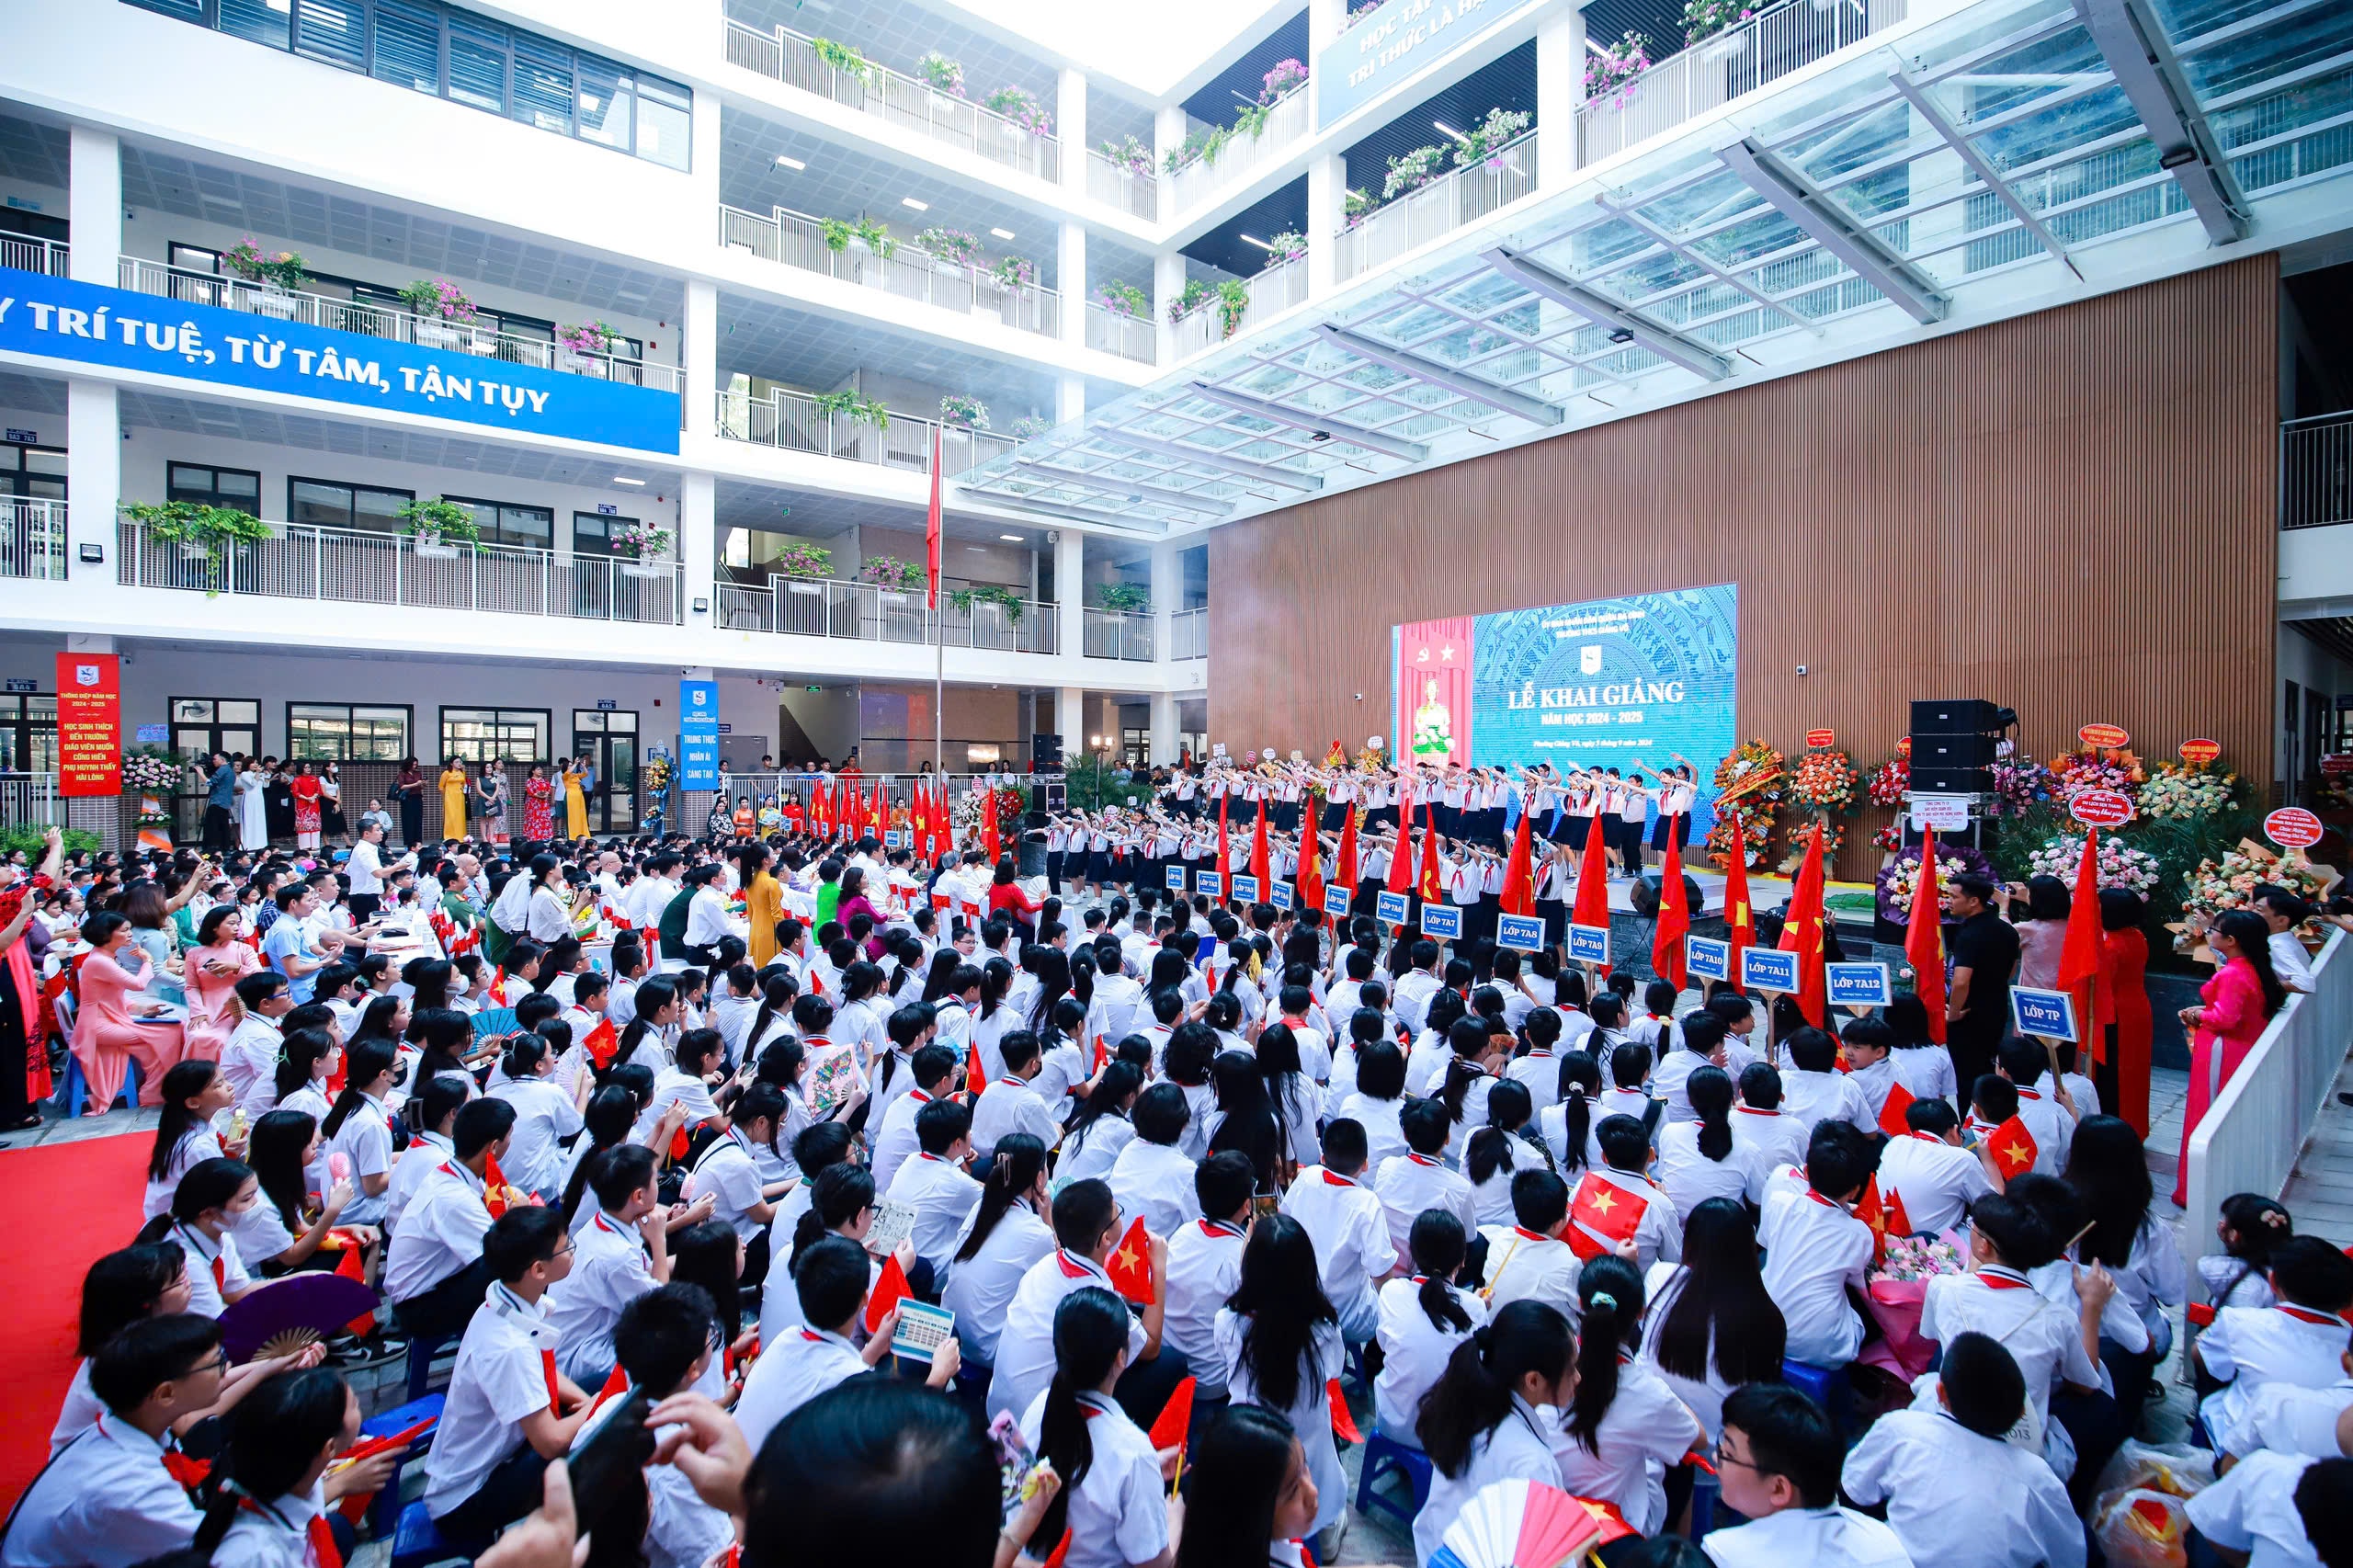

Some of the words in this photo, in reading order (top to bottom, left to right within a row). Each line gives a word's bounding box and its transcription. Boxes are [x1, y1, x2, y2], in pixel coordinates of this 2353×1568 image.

[1430, 5, 1454, 36] LÀ
[1360, 16, 1398, 53] HỌC
[27, 301, 110, 341] TRÍ
[116, 317, 216, 365] TUỆ,
[224, 334, 286, 369] TỪ
[292, 346, 390, 393] TÂM,
[398, 364, 472, 403] TẬN
[478, 381, 550, 416] TỤY
[1507, 681, 1535, 709] LỄ
[1540, 687, 1597, 709] KHAI
[1603, 676, 1685, 706] GIẢNG
[1541, 711, 1563, 725] NĂM
[1564, 712, 1585, 727] HỌC
[1586, 711, 1609, 724] 2024
[1619, 710, 1643, 723] 2025
[64, 722, 77, 731] HỌC
[95, 722, 113, 730] THÍCH
[684, 734, 701, 744] TRUNG
[689, 750, 705, 761] NHÂN
[63, 764, 76, 772] PHỤ
[702, 769, 713, 779] TẠO
[1234, 883, 1245, 892] LỚP
[1327, 893, 1336, 903] LỚP
[1380, 900, 1392, 910] LỚP
[1392, 904, 1403, 913] 7A6
[1427, 915, 1441, 925] LỚP
[1442, 918, 1456, 927] 7A7
[1503, 925, 1519, 936] LỚP
[1520, 929, 1538, 938] 7A8
[1573, 936, 1587, 948] LỚP
[1587, 940, 1603, 950] 7A9
[1691, 949, 1704, 961] LỚP
[1705, 954, 1722, 965] 7A10
[1748, 961, 1767, 973] LỚP
[1768, 966, 1790, 977] 7A11
[1833, 976, 1854, 988] LỚP
[1854, 979, 1881, 989] 7A12
[2023, 1004, 2044, 1019] LỚP
[2045, 1009, 2061, 1021] 7P
